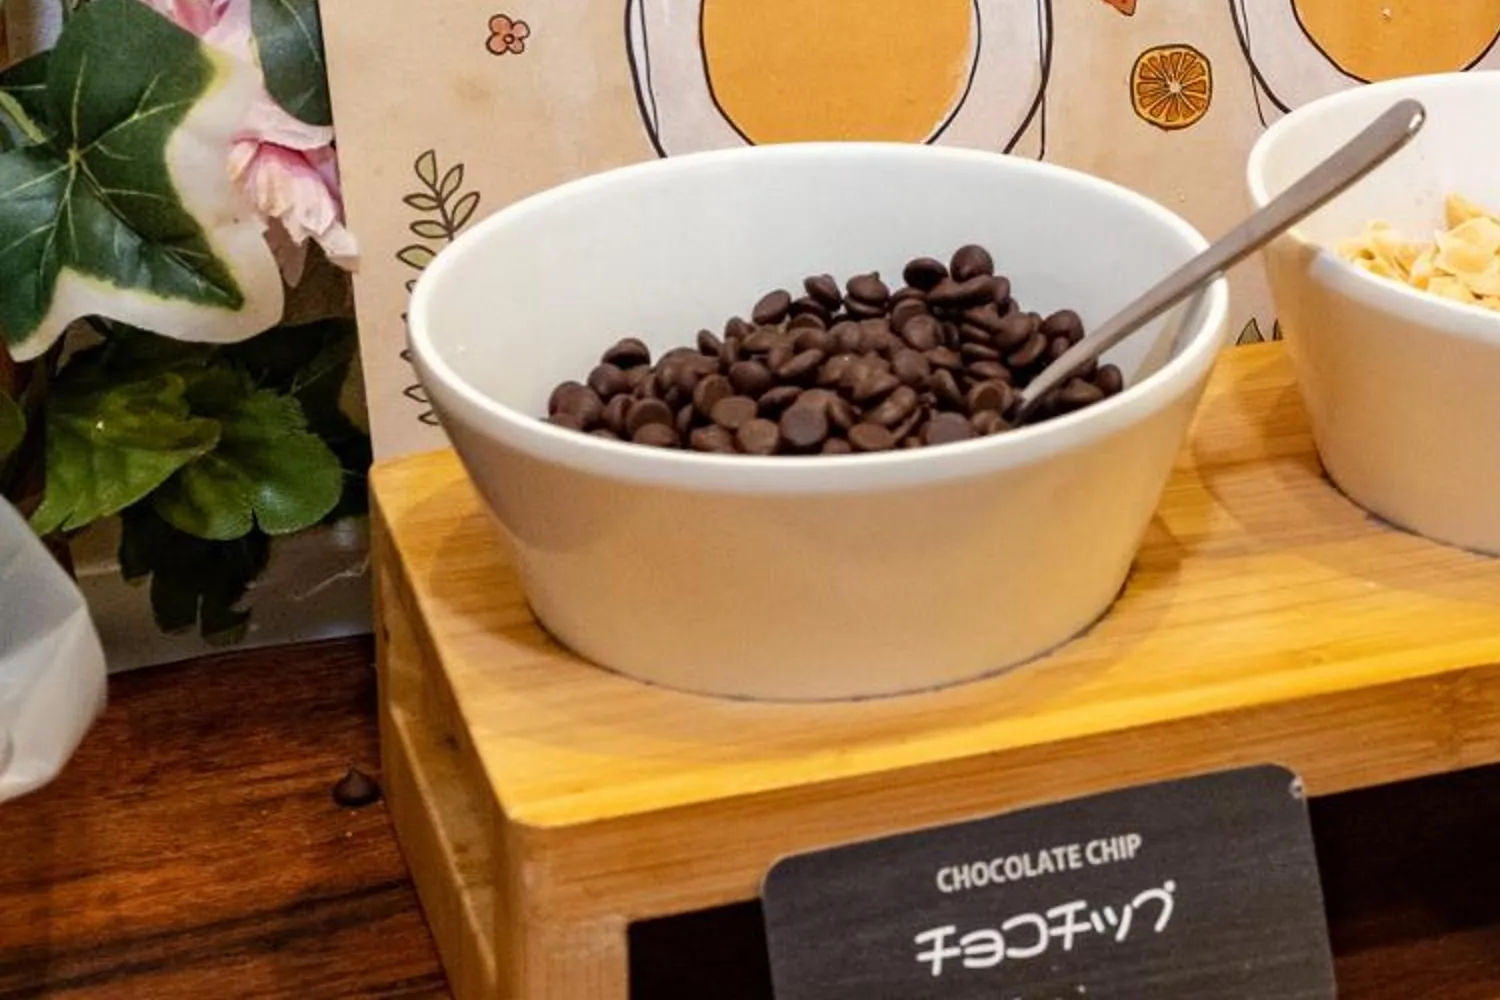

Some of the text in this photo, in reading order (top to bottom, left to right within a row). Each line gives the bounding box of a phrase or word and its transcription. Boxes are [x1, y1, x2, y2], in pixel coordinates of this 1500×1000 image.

[937, 832, 1143, 893] CHOCOLATE CHIP
[914, 880, 1177, 977] チョコチップ
